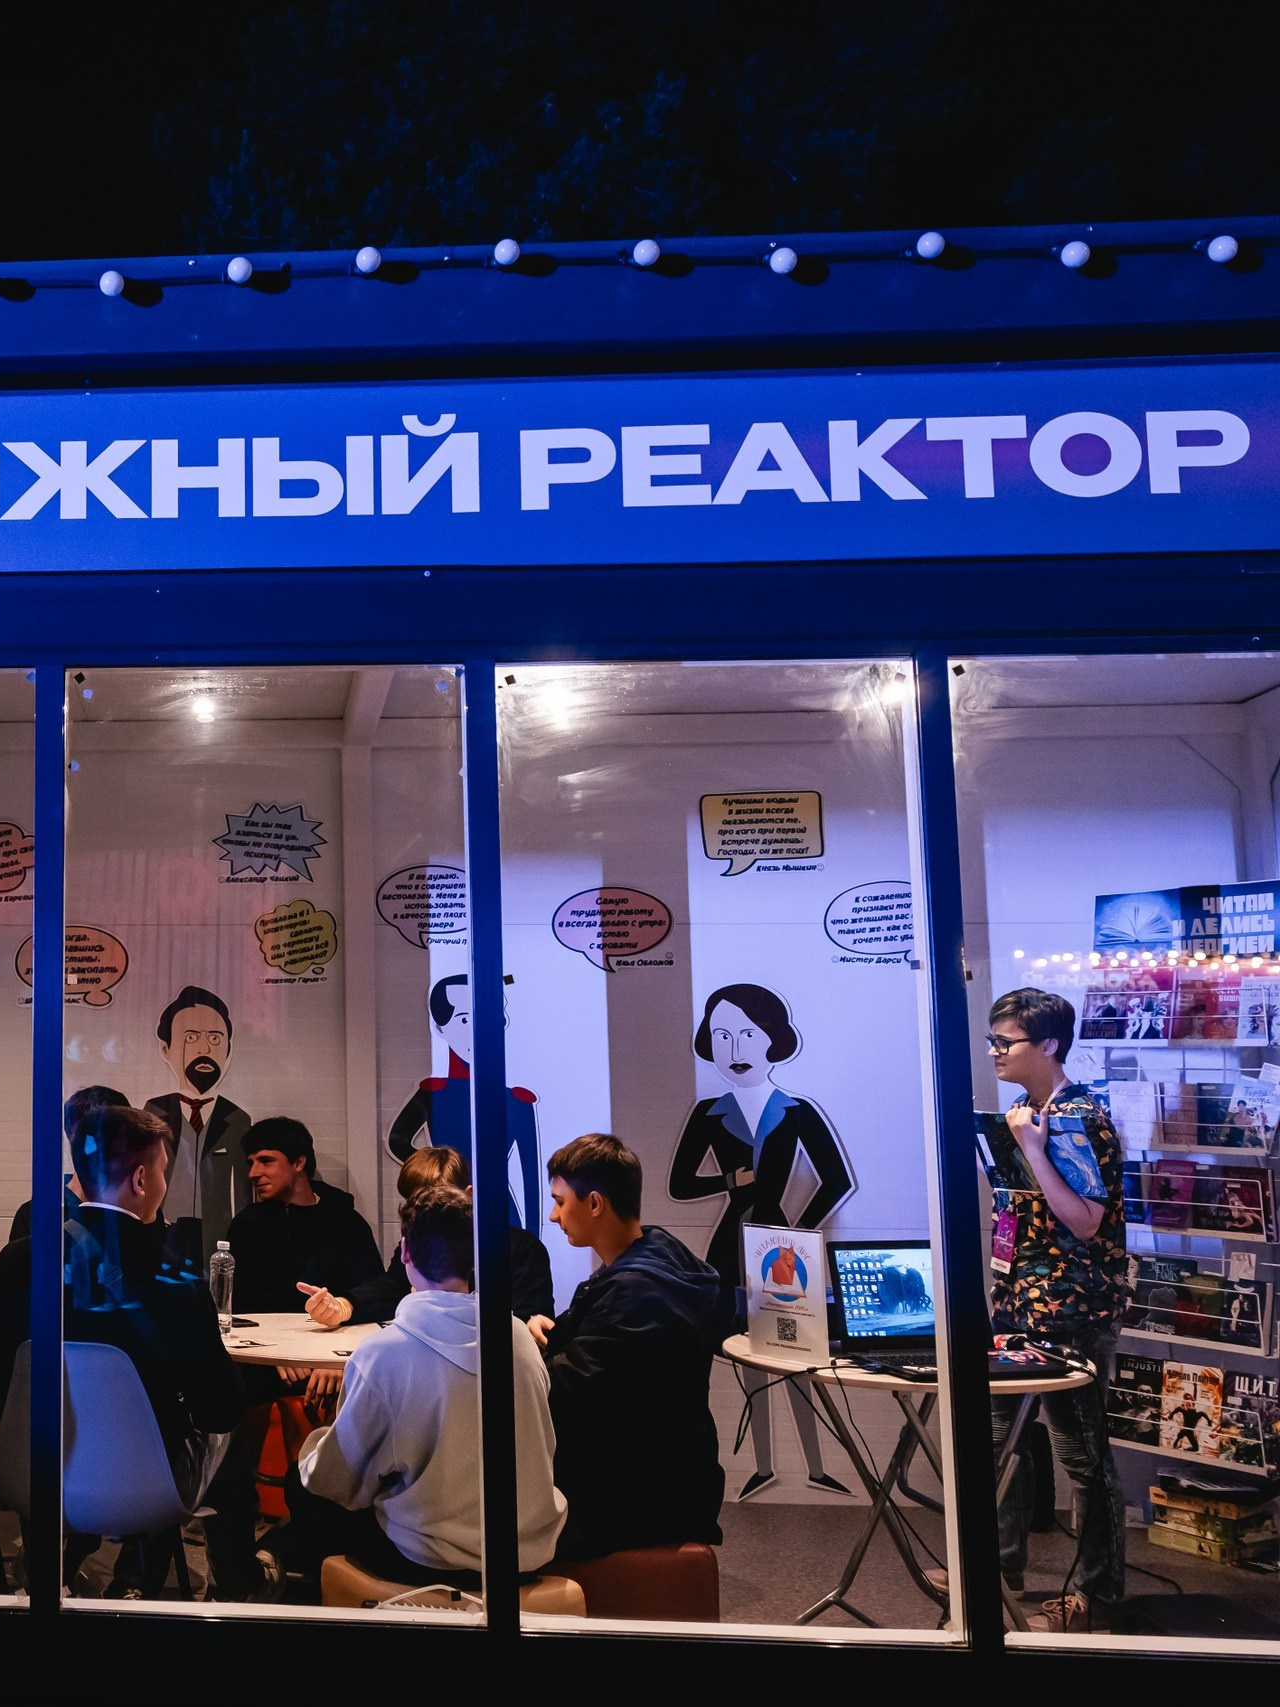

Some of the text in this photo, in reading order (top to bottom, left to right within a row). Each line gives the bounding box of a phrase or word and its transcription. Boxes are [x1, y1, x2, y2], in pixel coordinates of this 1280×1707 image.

[519, 409, 1250, 511] РЕАКТОР
[722, 798, 764, 806] Лучшими
[721, 838, 760, 846] встрече
[596, 897, 628, 906] Самую
[570, 909, 616, 917] трудную
[852, 904, 894, 914] признаки
[851, 915, 893, 924] женщина
[599, 920, 629, 928] делаю
[1172, 914, 1275, 936] И ДЕЛИСЬ
[838, 927, 866, 935] такие
[852, 937, 881, 945] хочет
[597, 942, 638, 950] кровати
[840, 956, 874, 964] Мистер
[70, 966, 118, 974] закопать
